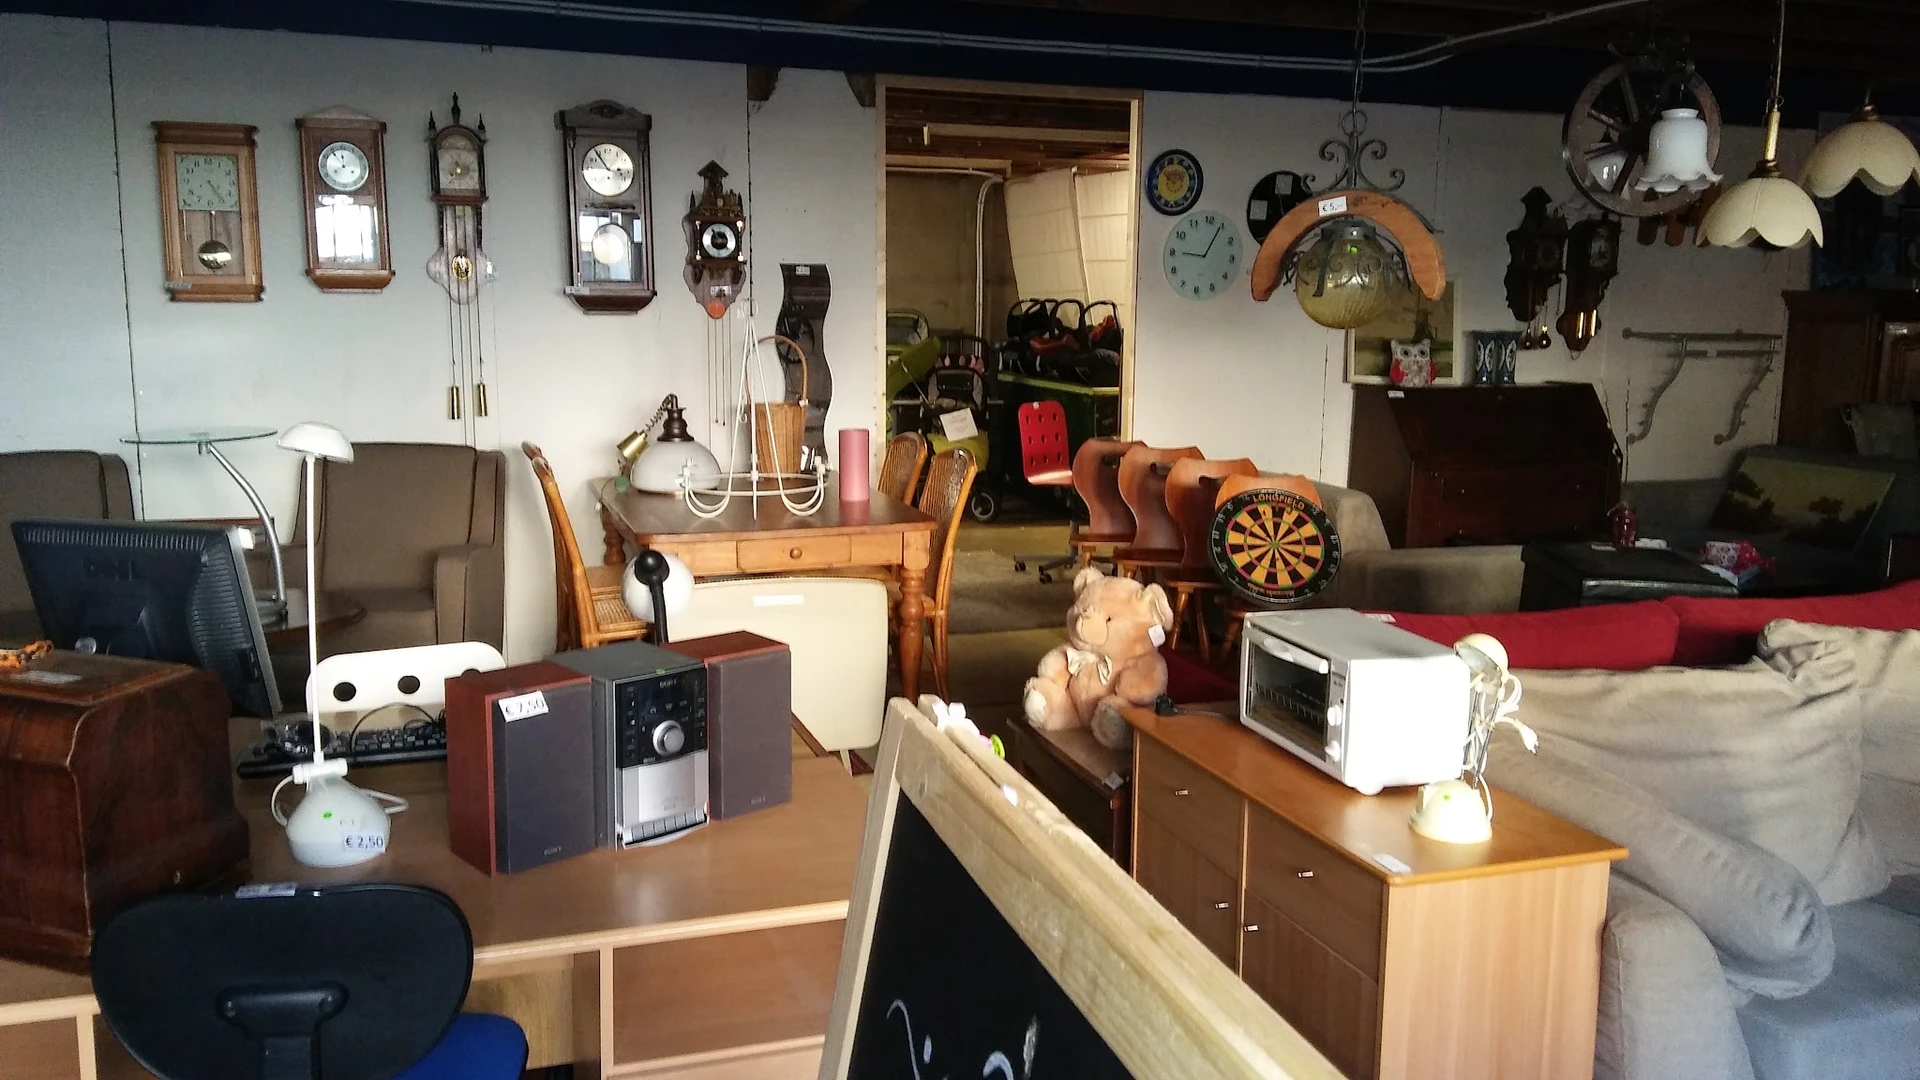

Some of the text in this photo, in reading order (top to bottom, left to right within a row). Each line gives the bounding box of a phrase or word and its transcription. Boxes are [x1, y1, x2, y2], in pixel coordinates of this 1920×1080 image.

[1189, 219, 1199, 228] 11
[1205, 215, 1215, 226] 12
[1176, 231, 1186, 241] 10
[1253, 494, 1305, 511] LONGFIELD
[357, 835, 384, 850] 2,50
